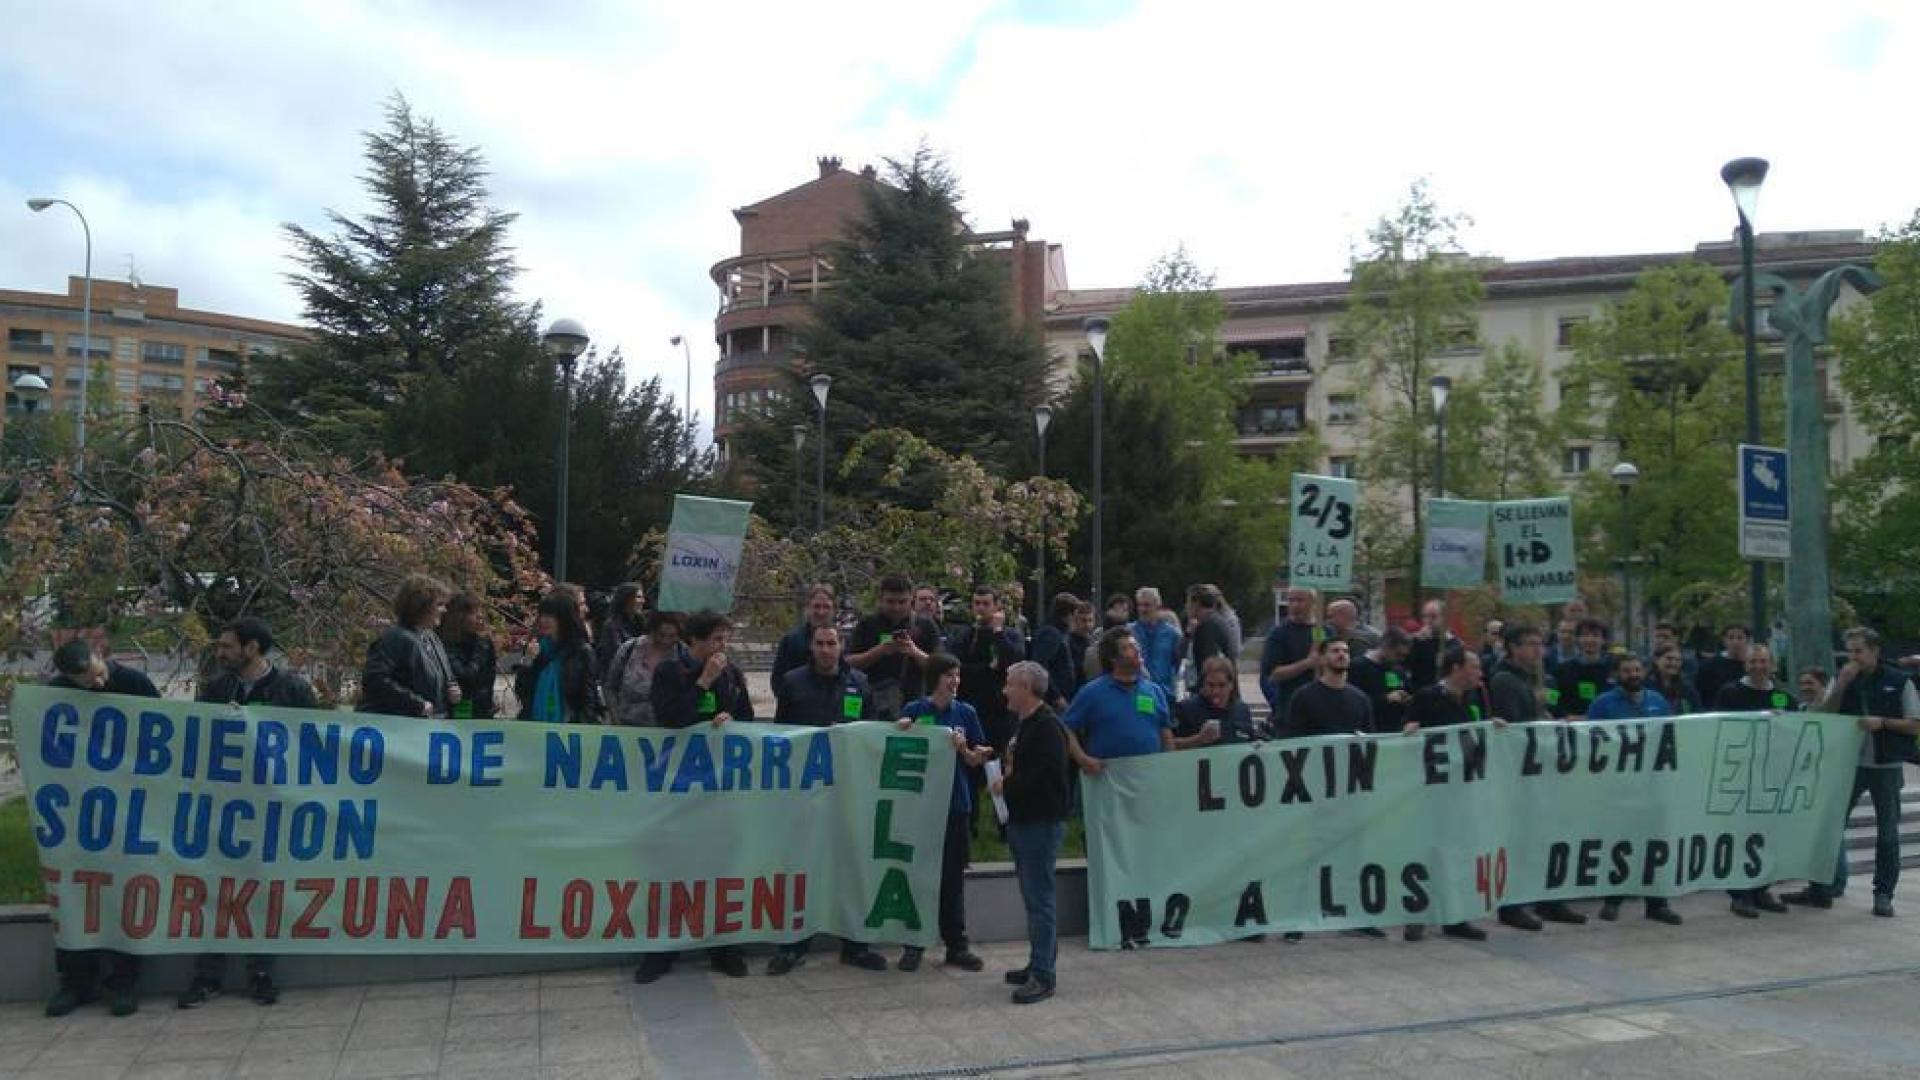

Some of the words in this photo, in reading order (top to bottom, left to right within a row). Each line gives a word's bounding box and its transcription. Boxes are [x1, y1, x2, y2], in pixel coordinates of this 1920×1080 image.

[1299, 483, 1353, 540] 2/3
[1520, 523, 1543, 538] EL
[671, 554, 720, 569] LOXIN
[1295, 562, 1341, 577] CALLE
[1298, 542, 1308, 556] A
[1316, 543, 1339, 558] LA
[1504, 540, 1553, 568] I+D
[1504, 570, 1575, 590] NAVARRO
[40, 702, 386, 786] GOBIERNO
[427, 731, 505, 786] DE
[543, 731, 834, 793] NAVARRA
[1197, 741, 1379, 811] LOXIN
[1423, 728, 1486, 784] EN
[1521, 722, 1678, 777] LUCHA
[1705, 718, 1824, 815] ELA
[35, 783, 378, 862] SOLUCION
[865, 735, 930, 931] ELA
[519, 873, 806, 939] LOXINEN!
[1117, 893, 1190, 949] NO
[1234, 880, 1268, 927] A
[1320, 862, 1431, 918] LOS
[1476, 847, 1508, 911] 40
[1545, 832, 1766, 889] DESPIDOS
